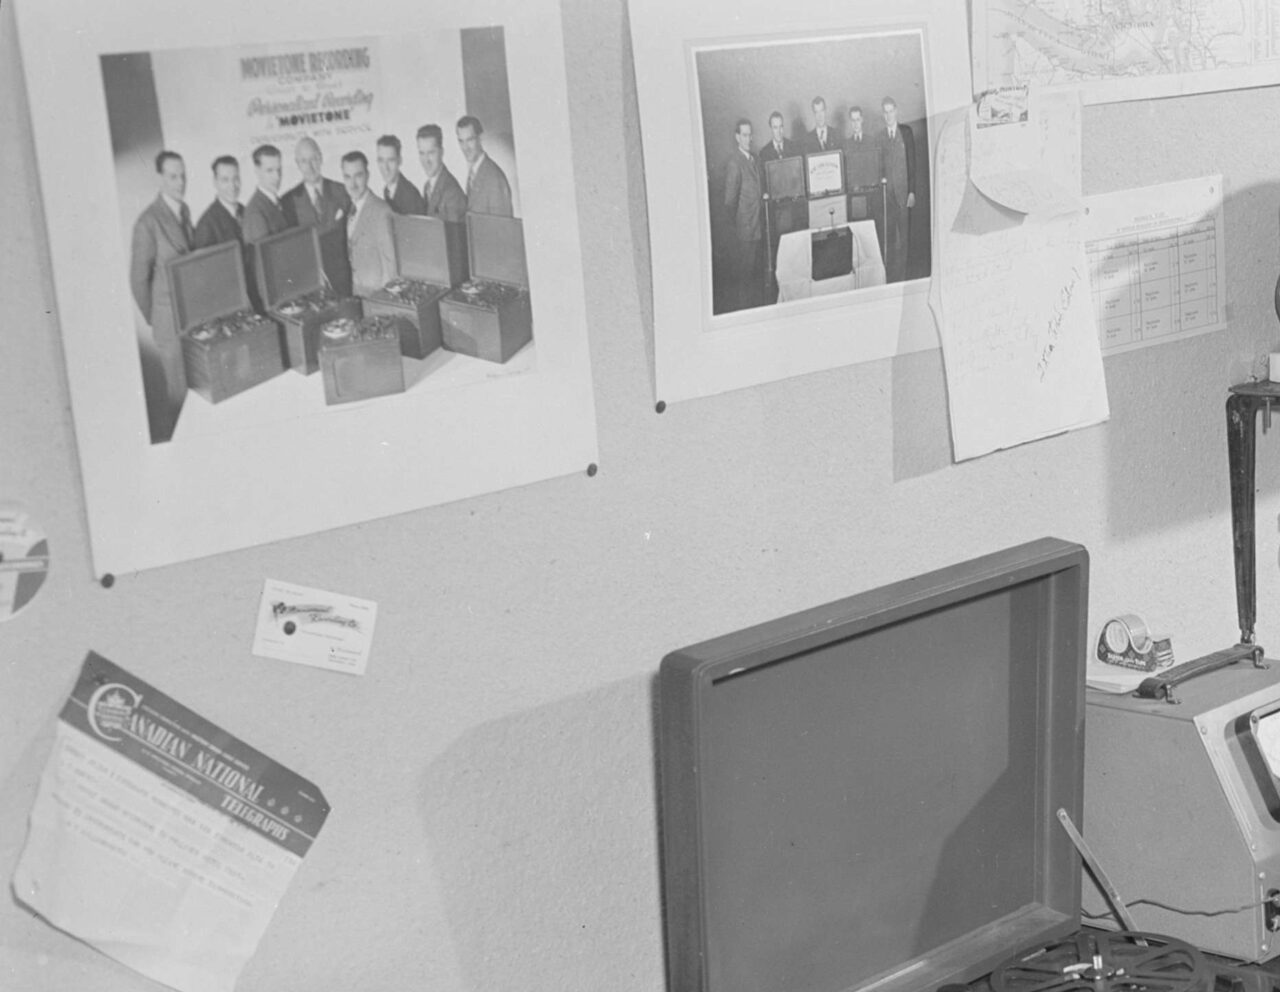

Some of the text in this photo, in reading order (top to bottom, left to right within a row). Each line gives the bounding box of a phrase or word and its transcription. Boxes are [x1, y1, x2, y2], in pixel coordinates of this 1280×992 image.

[87, 683, 193, 760] CANADIAN
[194, 750, 265, 804] NATIONAL
[219, 793, 291, 842] TELEGRAPHS
